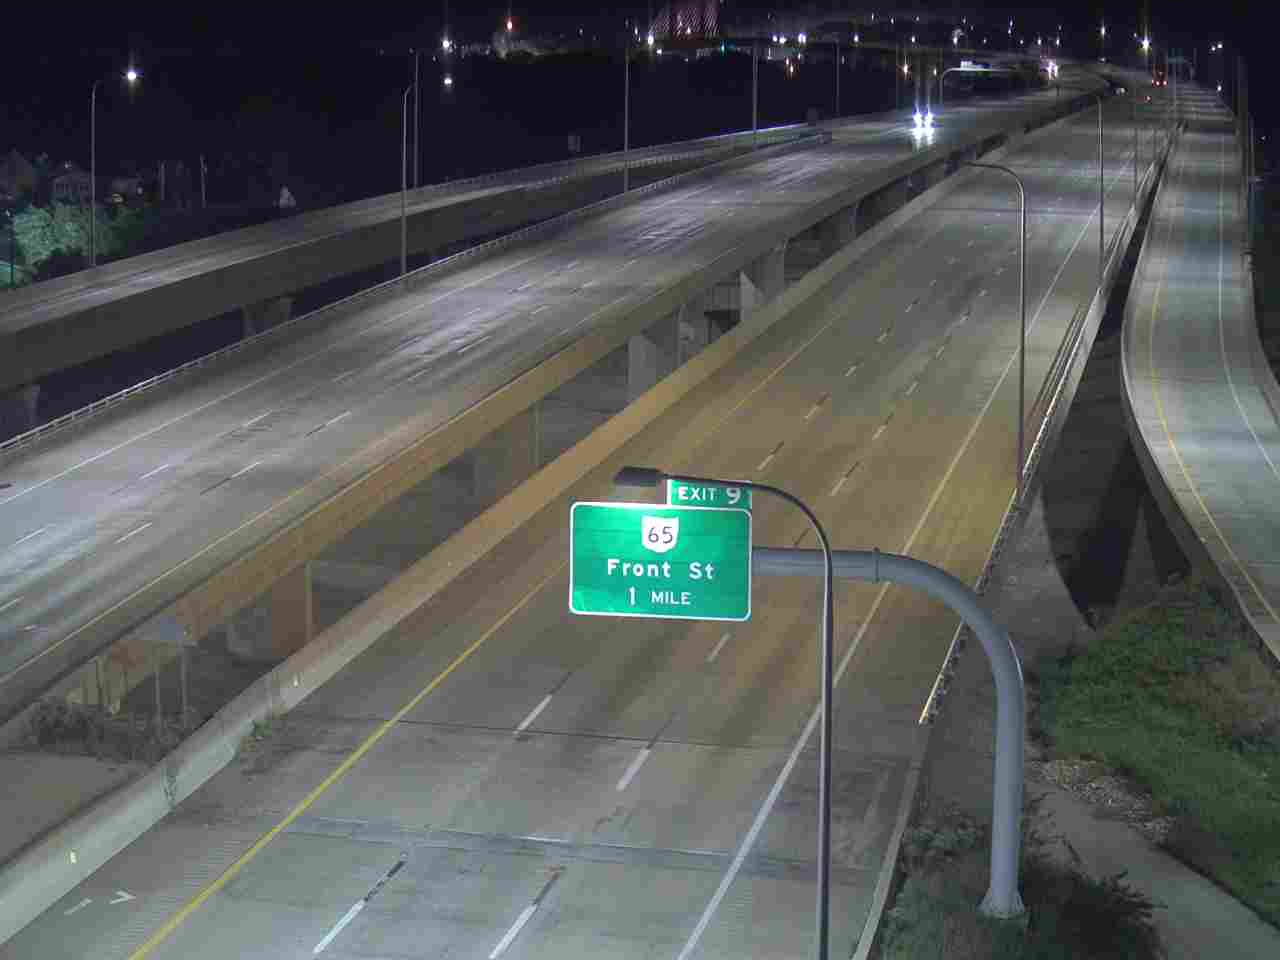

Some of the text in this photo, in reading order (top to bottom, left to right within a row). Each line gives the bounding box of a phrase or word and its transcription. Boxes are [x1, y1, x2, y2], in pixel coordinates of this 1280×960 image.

[678, 486, 741, 505] EXIT 9
[647, 525, 674, 544] 65
[606, 558, 716, 580] Front St
[628, 586, 692, 606] 1 MILE
